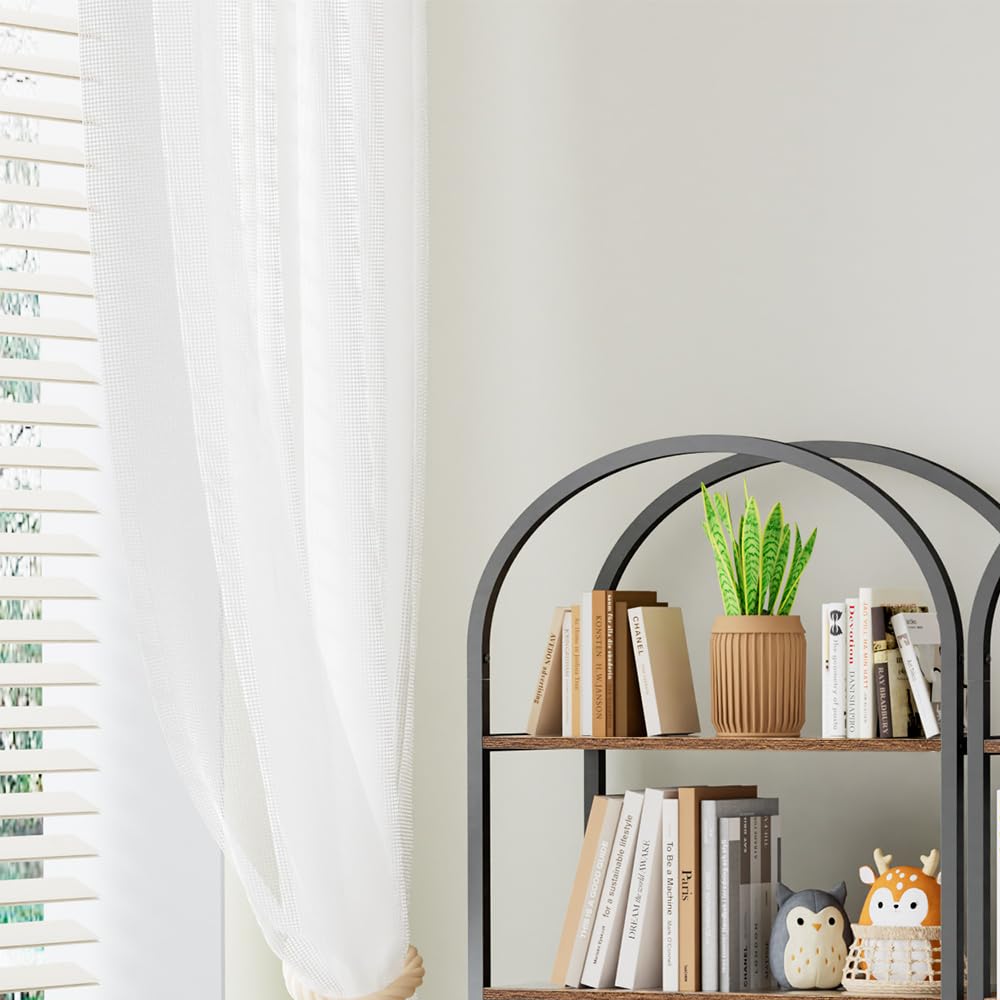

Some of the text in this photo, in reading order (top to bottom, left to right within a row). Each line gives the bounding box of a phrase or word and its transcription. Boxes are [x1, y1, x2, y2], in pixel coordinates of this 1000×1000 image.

[595, 615, 603, 657] KONSTEN
[632, 616, 644, 655] CHANEL
[533, 633, 557, 704] AVEDON advertising
[878, 667, 888, 734] RAY BRADBURY
[602, 904, 611, 919] for
[609, 853, 626, 897] sustainable
[620, 814, 633, 853] lifestyle
[666, 842, 674, 852] To
[667, 854, 674, 867] Be
[628, 903, 641, 940] DREAM
[639, 839, 651, 871] AWAKE
[666, 877, 674, 916] Machine
[682, 870, 693, 902] Paris
